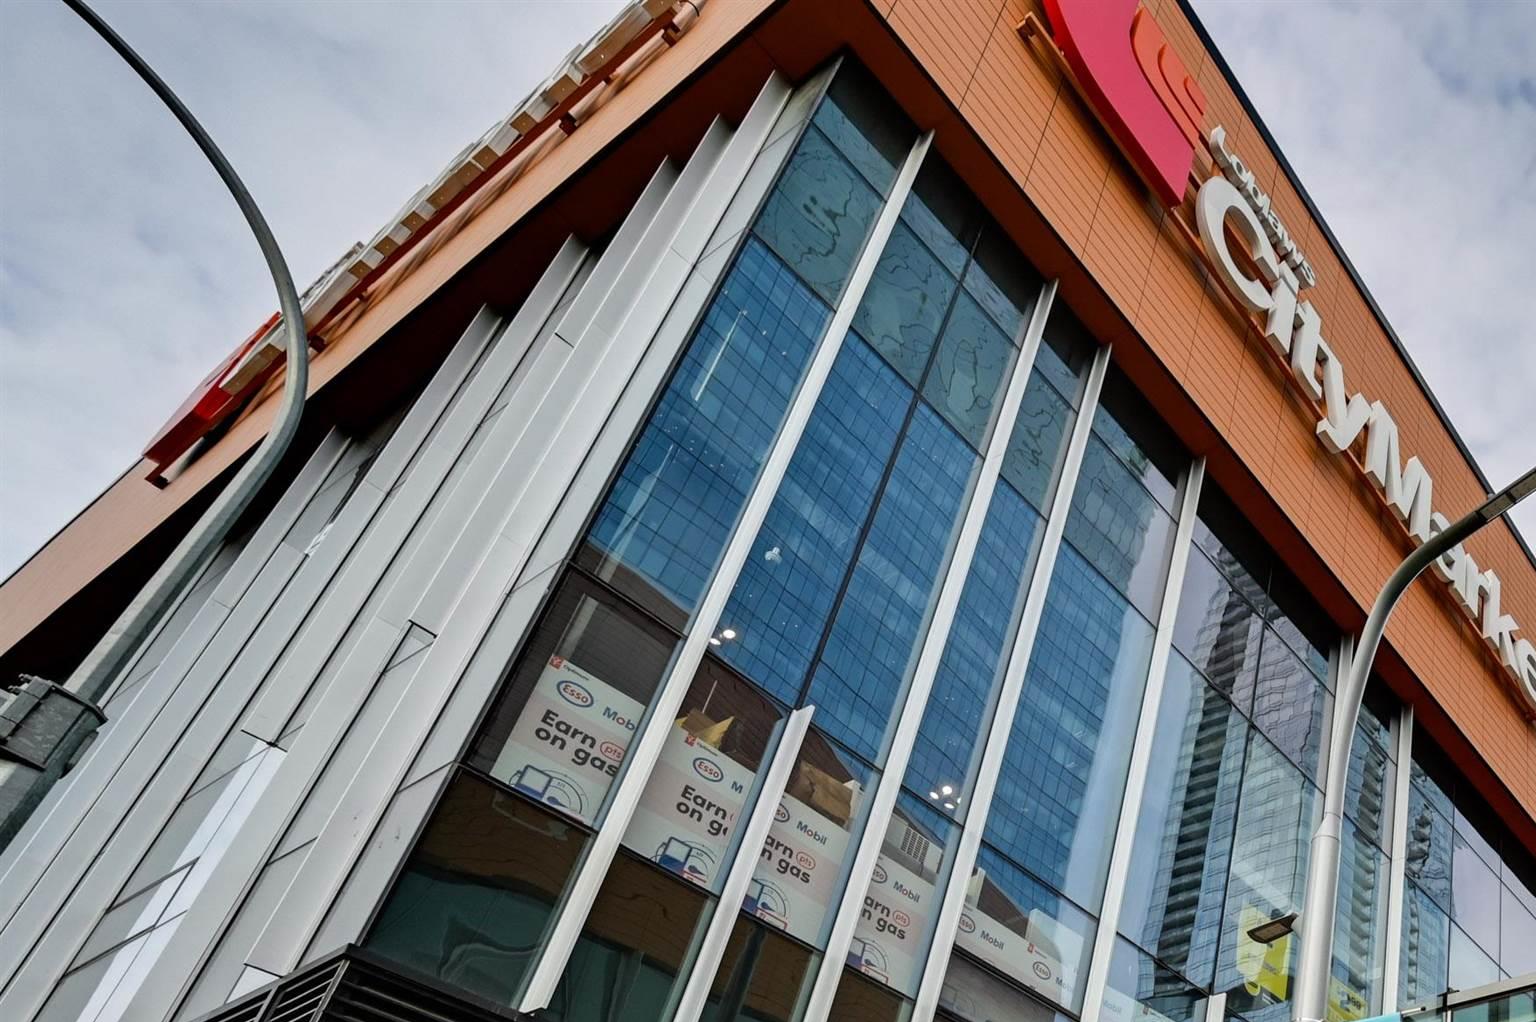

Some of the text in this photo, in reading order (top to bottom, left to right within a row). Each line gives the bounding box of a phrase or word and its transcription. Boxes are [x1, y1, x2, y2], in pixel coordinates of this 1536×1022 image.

[562, 683, 589, 704] Esso
[541, 709, 597, 749] Earn
[535, 727, 619, 777] on gas
[697, 761, 719, 778] Esso
[676, 801, 703, 823] on
[680, 784, 727, 820] Earn
[796, 821, 827, 845] Mobil
[765, 835, 793, 859] arn
[776, 858, 811, 884] gas
[893, 880, 920, 903] Mobil
[864, 896, 890, 918] arn
[876, 918, 906, 940] gas
[980, 929, 1004, 950] Mobil
